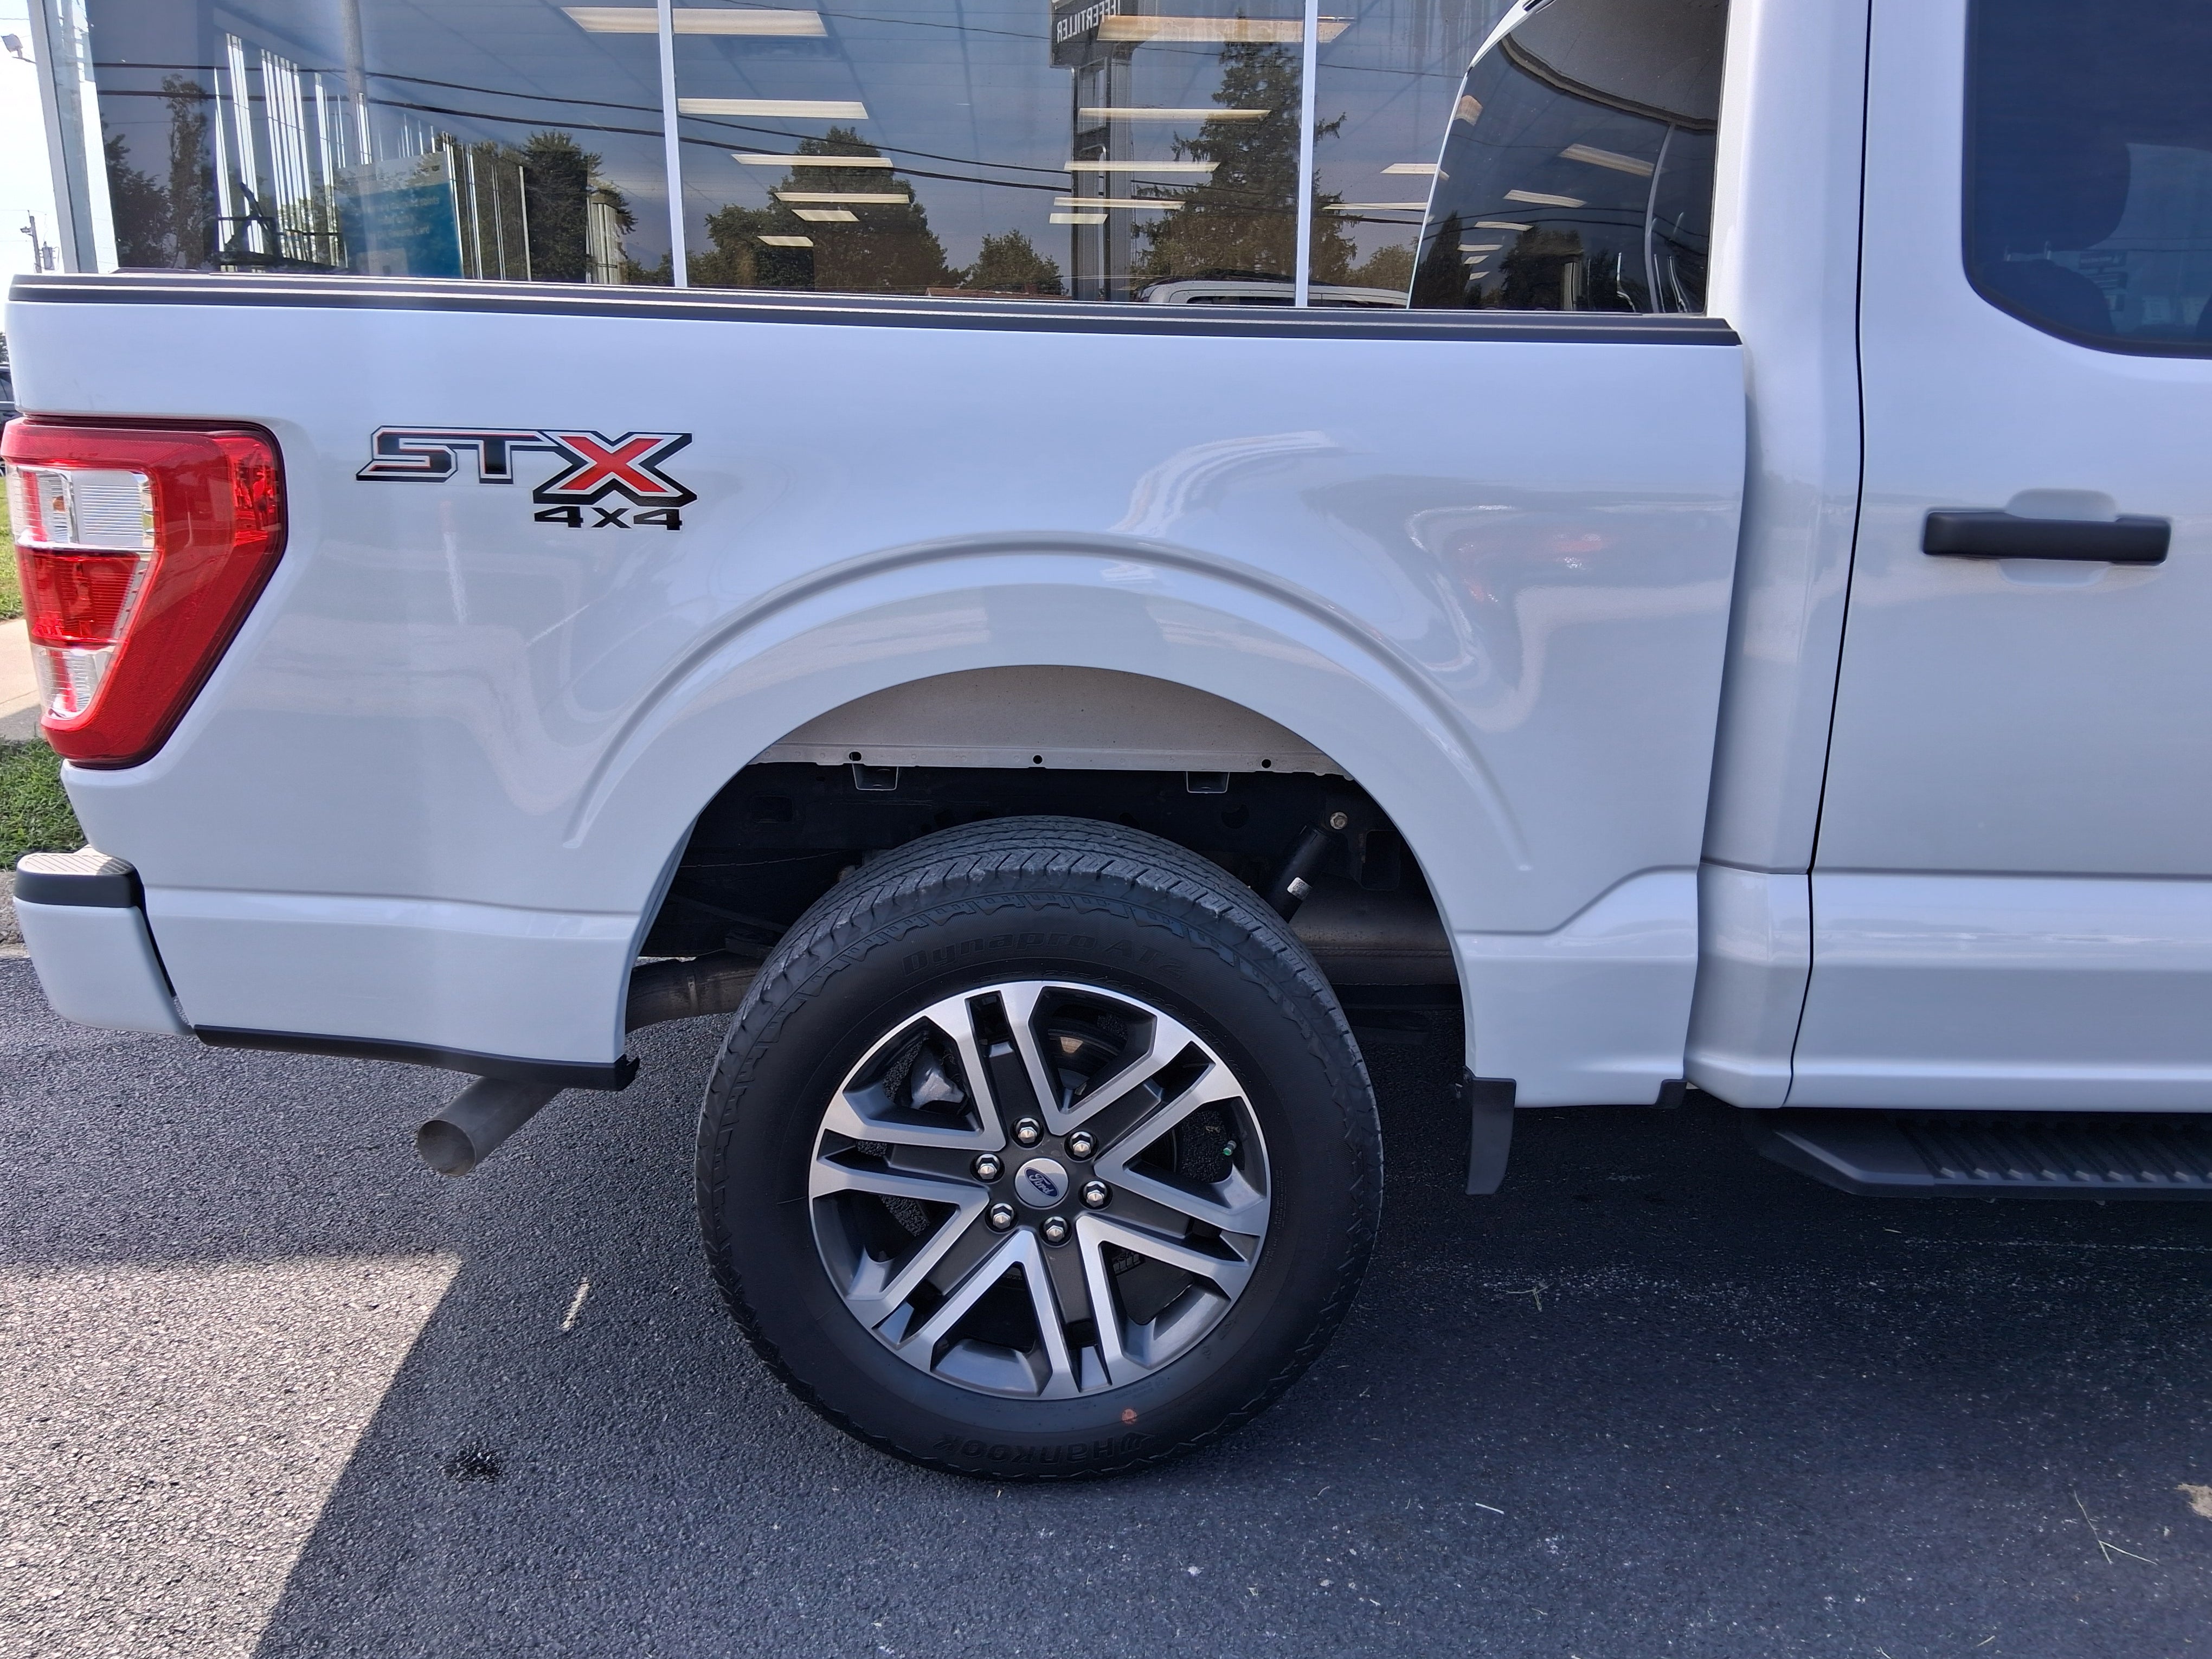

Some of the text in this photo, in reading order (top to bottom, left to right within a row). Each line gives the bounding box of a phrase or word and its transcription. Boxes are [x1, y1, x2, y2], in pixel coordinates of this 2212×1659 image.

[356, 425, 698, 507] STX
[901, 931, 1097, 976] Dynapro
[1028, 1173, 1054, 1194] Ford
